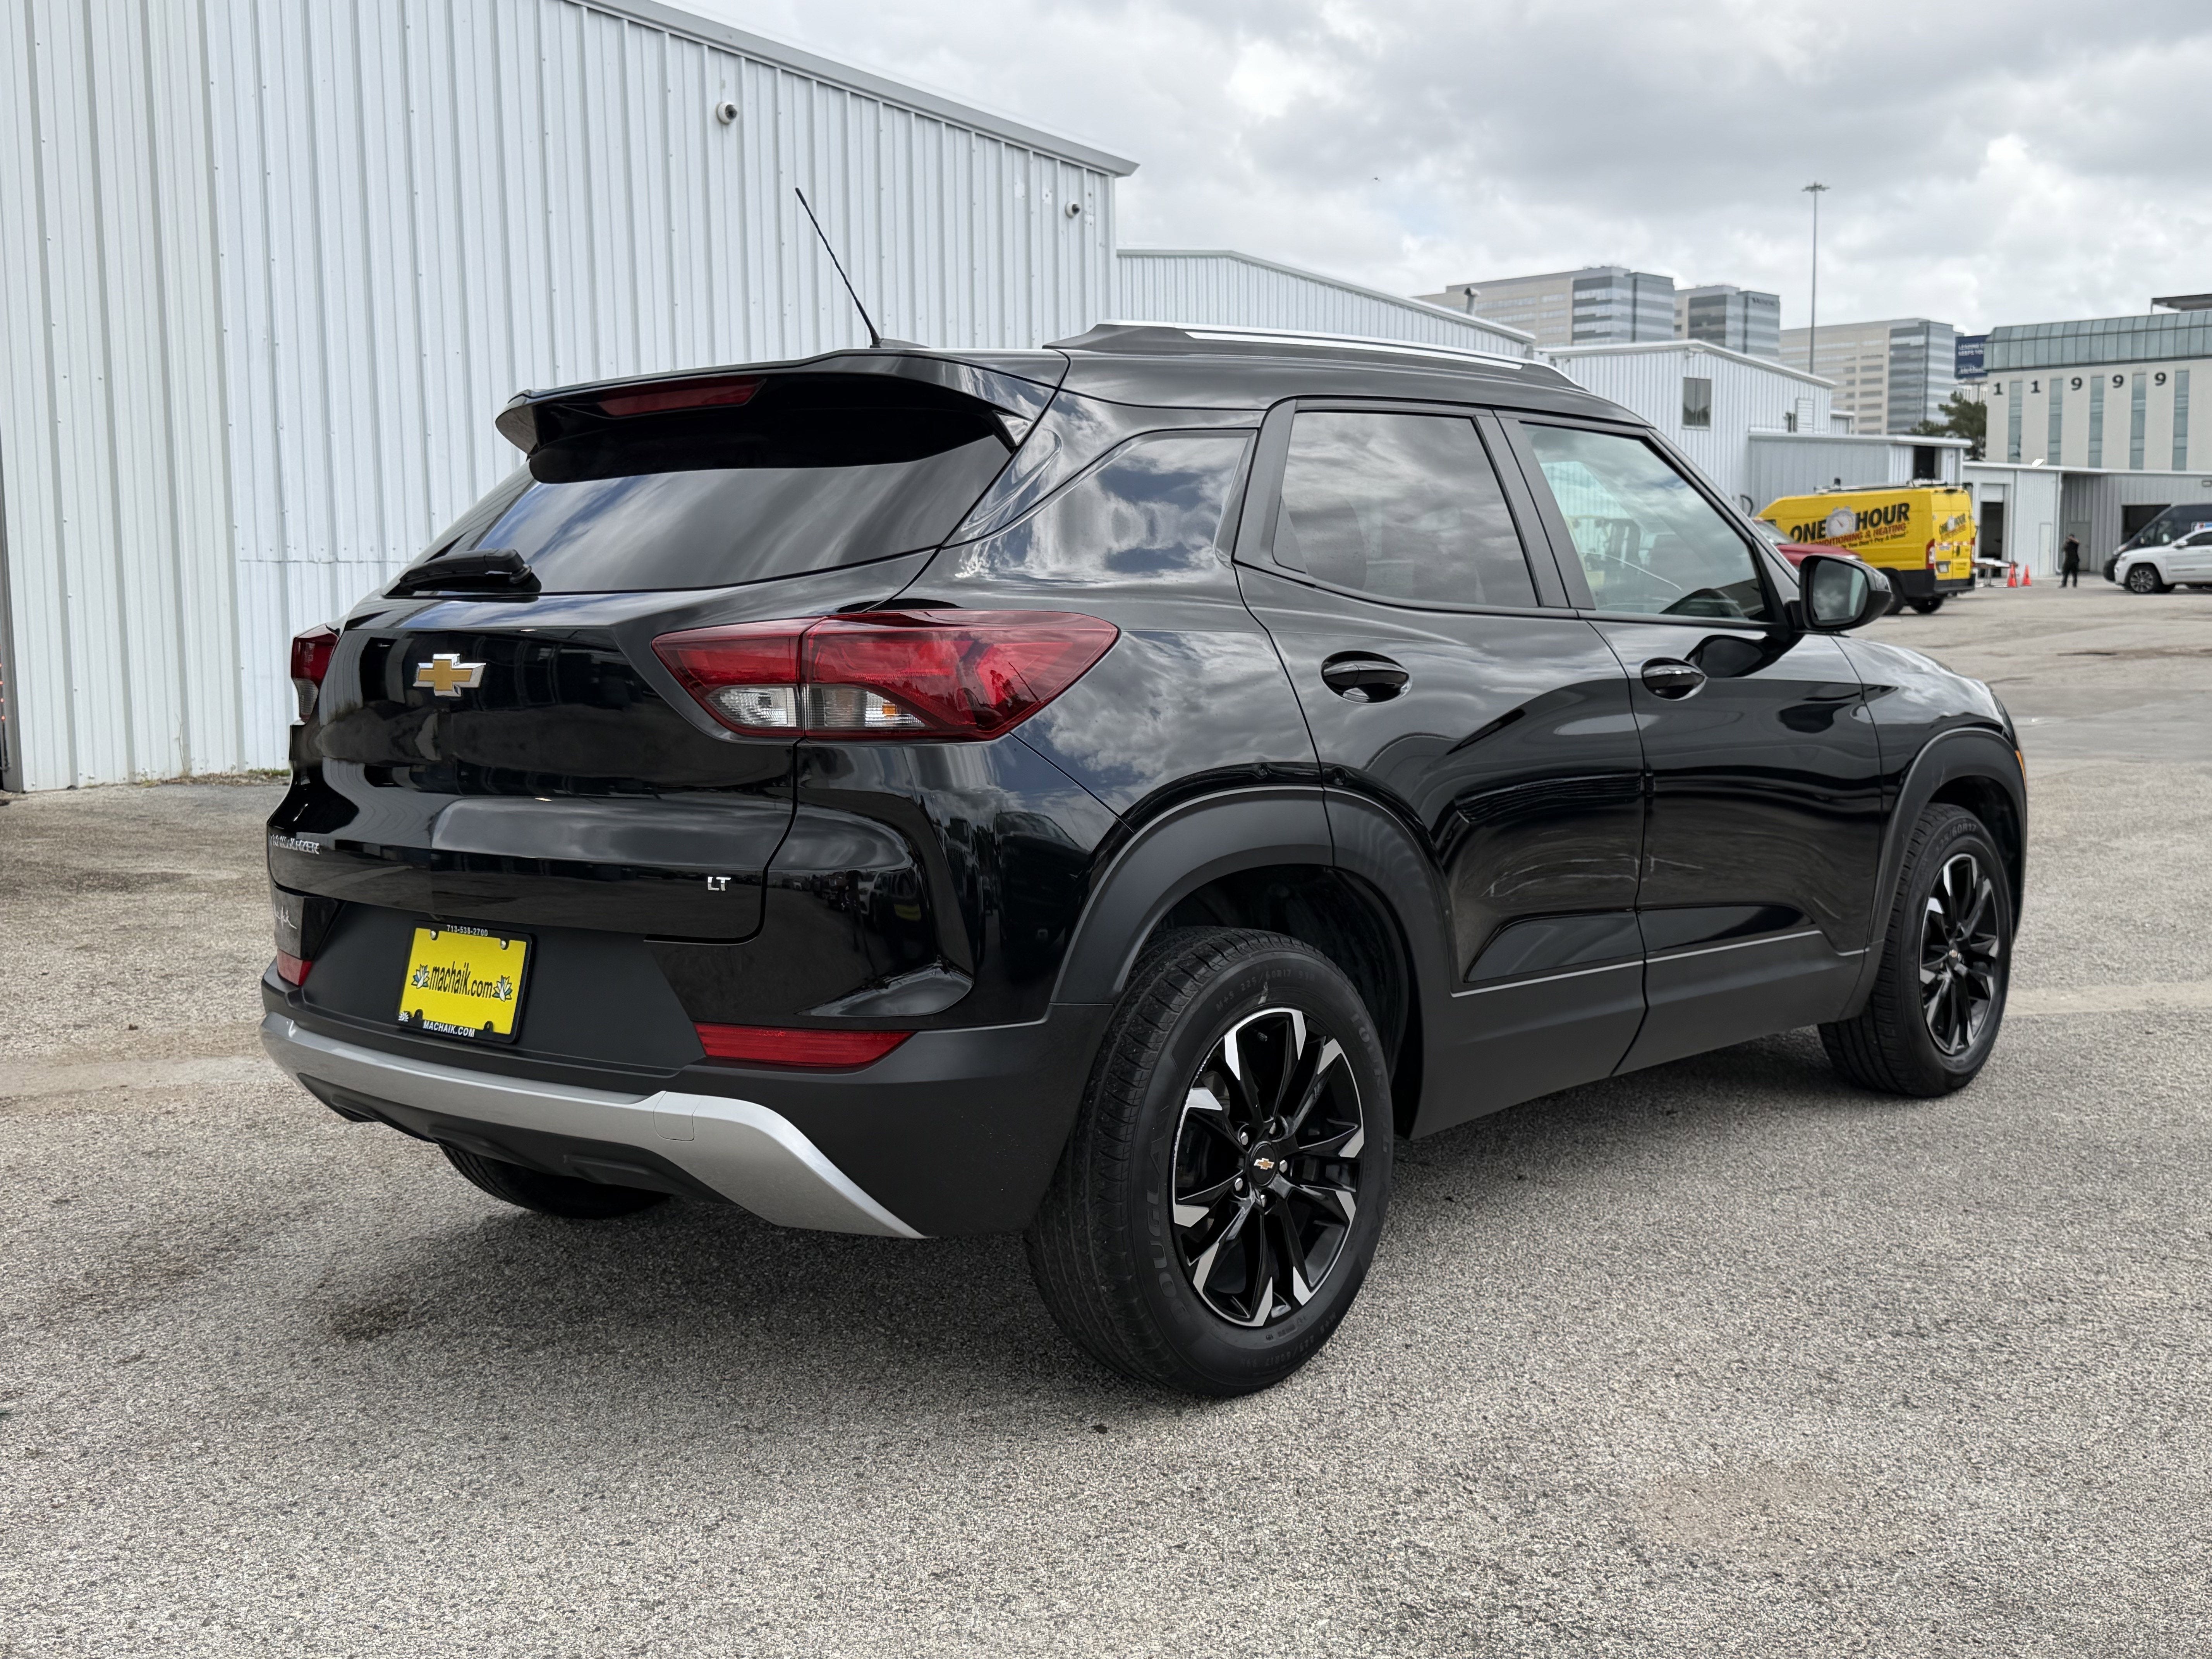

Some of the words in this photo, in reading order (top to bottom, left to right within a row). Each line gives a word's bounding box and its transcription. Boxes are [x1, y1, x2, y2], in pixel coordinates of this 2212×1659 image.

[1790, 519, 1827, 542] ONE
[1855, 503, 1910, 531] HOUR
[1874, 523, 1906, 536] HEATING
[708, 876, 732, 891] LT
[429, 961, 493, 999] machaik.com
[423, 1020, 476, 1037] MACHAIK.COM
